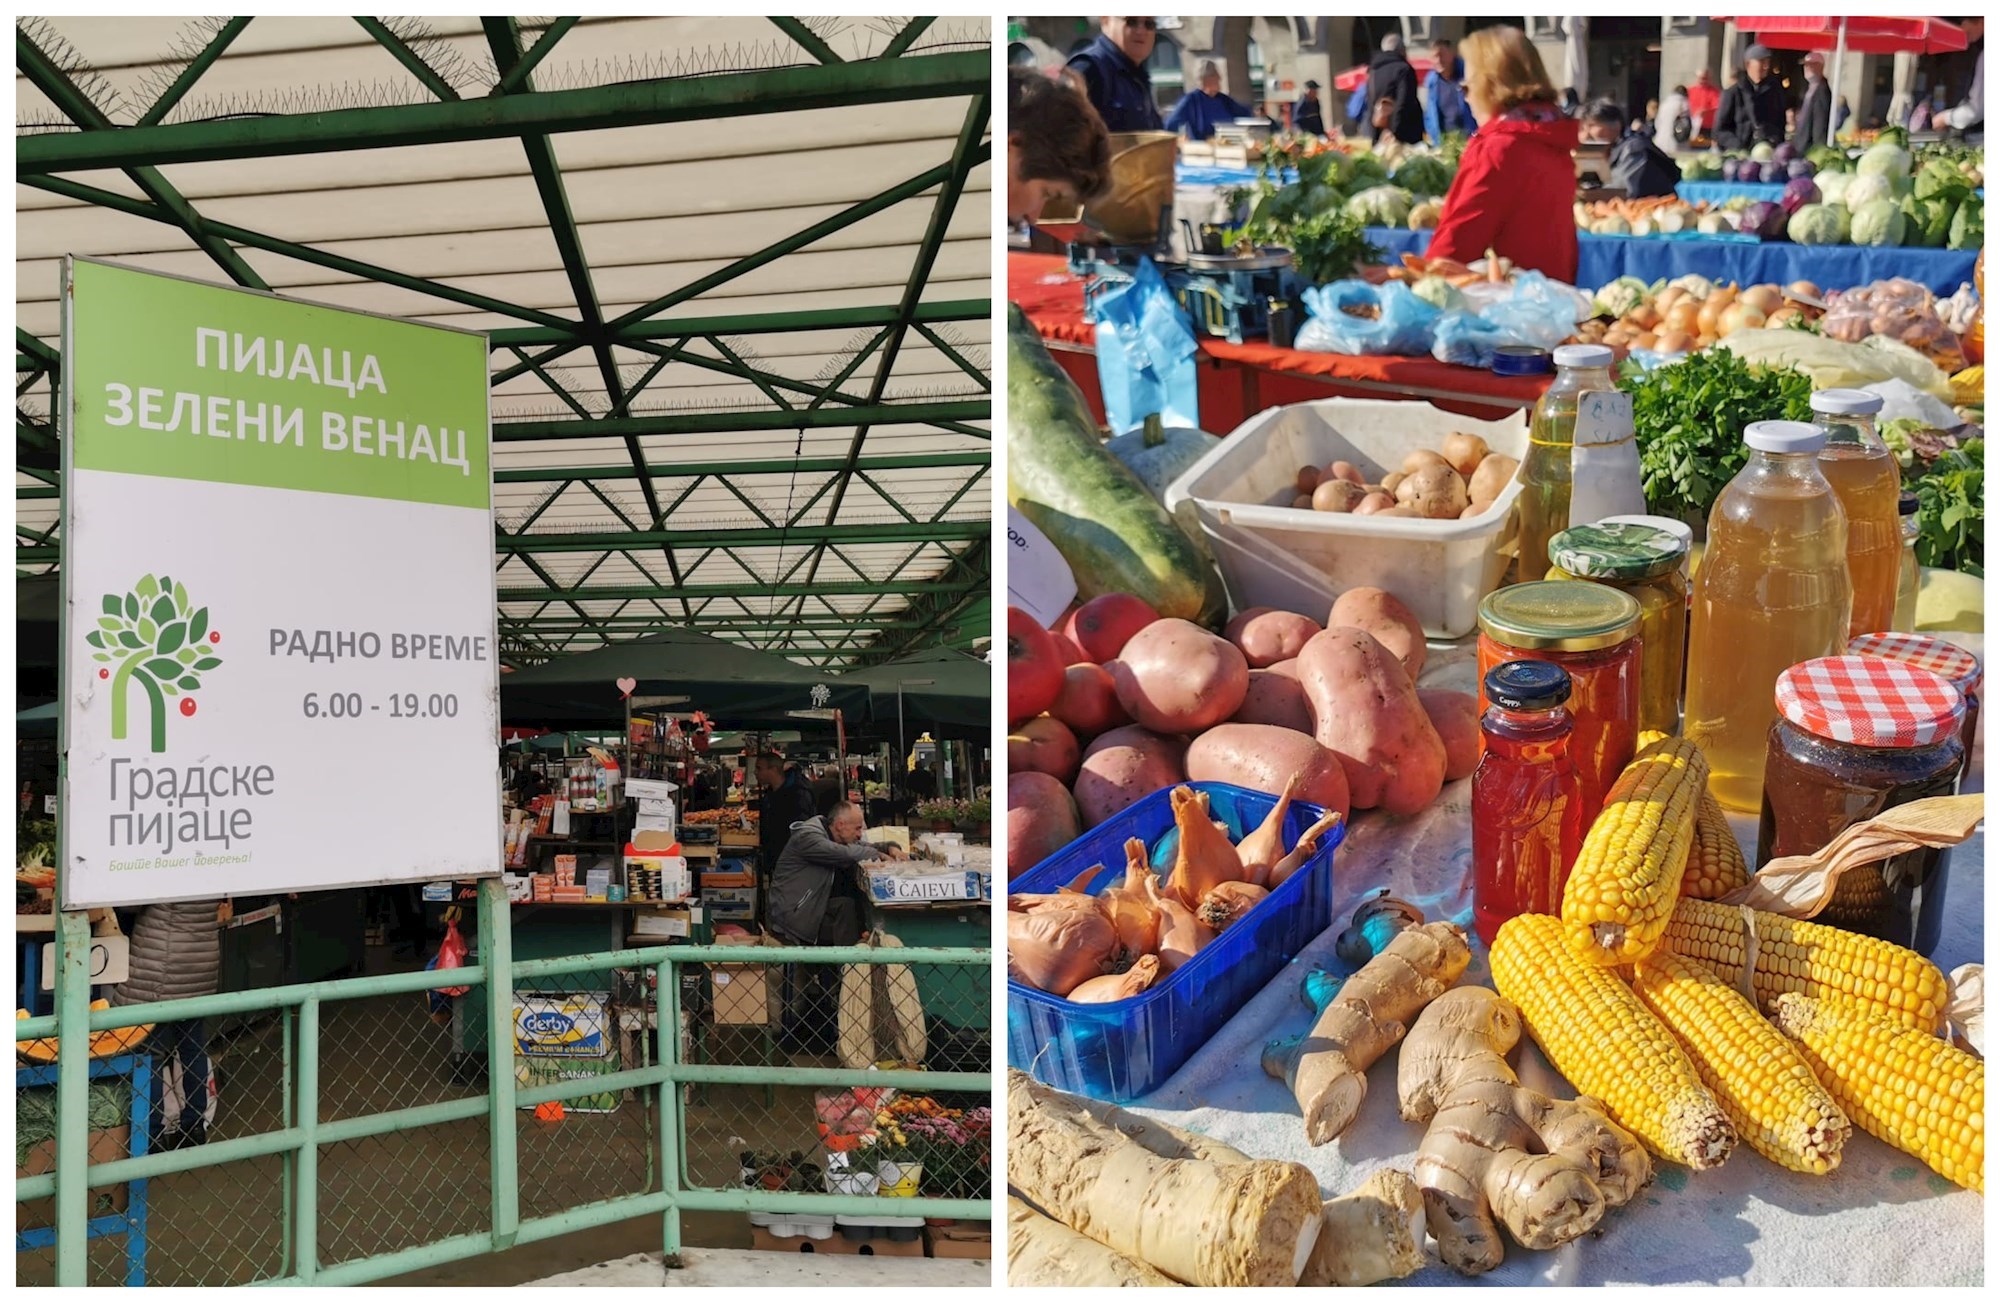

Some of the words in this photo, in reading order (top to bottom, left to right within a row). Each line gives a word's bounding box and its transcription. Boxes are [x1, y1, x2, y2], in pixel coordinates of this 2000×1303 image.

[196, 327, 387, 398] ПИЈАЦА
[105, 383, 303, 446] ЗЕЛЕНИ
[322, 411, 470, 476] ВЕНАЦ
[1008, 527, 1029, 551] OD:
[270, 629, 381, 663] РАДНО
[391, 633, 487, 661] ВРЕМЕ
[303, 693, 362, 718] 6.00
[389, 693, 458, 718] 19.00
[110, 758, 274, 811] Градске
[110, 800, 252, 854] пијаце
[899, 880, 956, 898] ČAJEVI
[527, 1014, 571, 1034] derby
